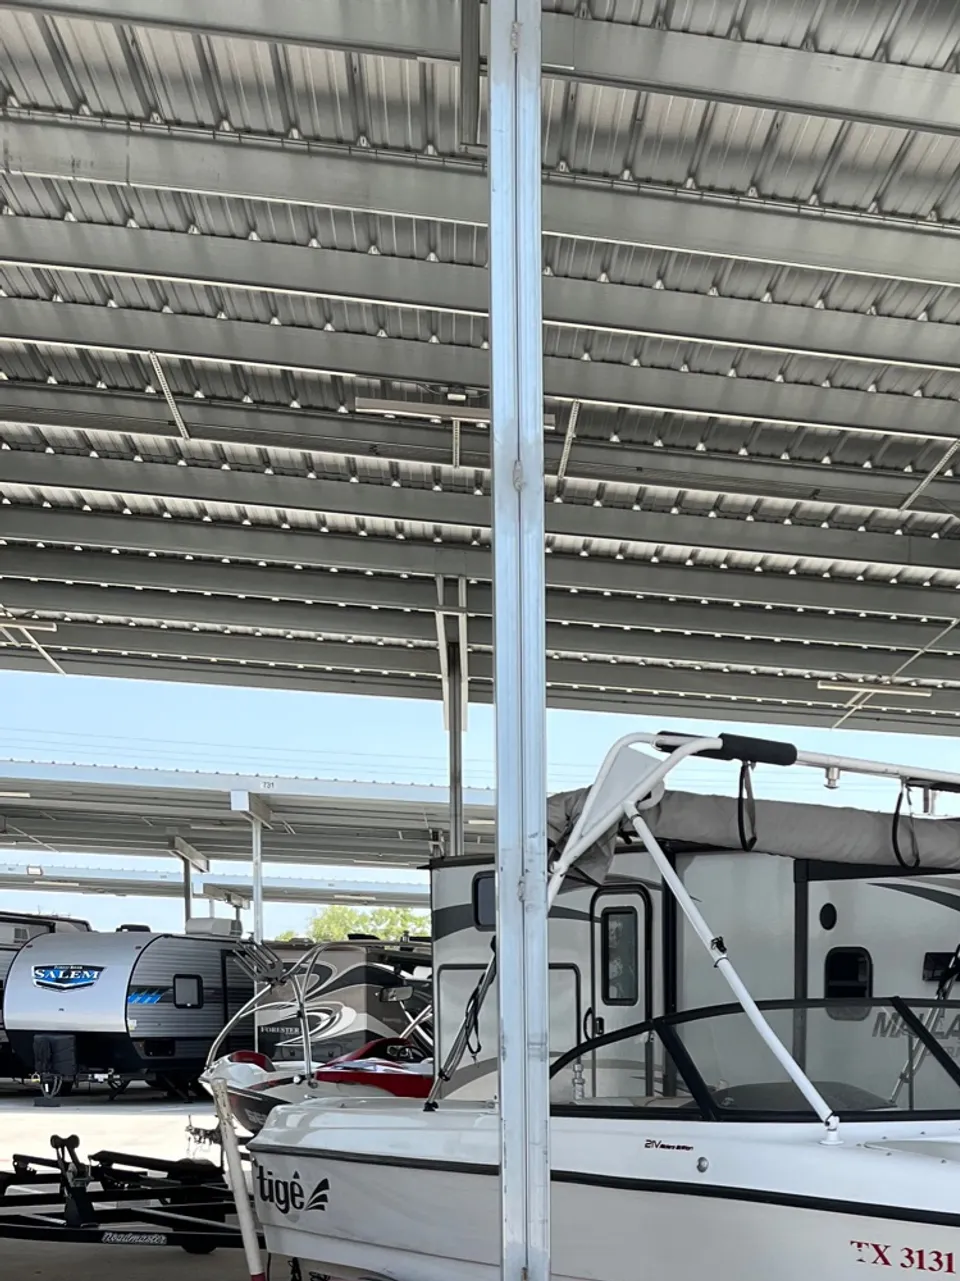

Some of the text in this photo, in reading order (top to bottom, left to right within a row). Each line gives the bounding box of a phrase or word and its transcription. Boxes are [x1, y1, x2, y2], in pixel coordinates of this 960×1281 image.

[34, 969, 100, 979] SALEM
[260, 1026, 300, 1035] FORESTER
[850, 1240, 893, 1267] TX
[900, 1247, 956, 1274] 3131
